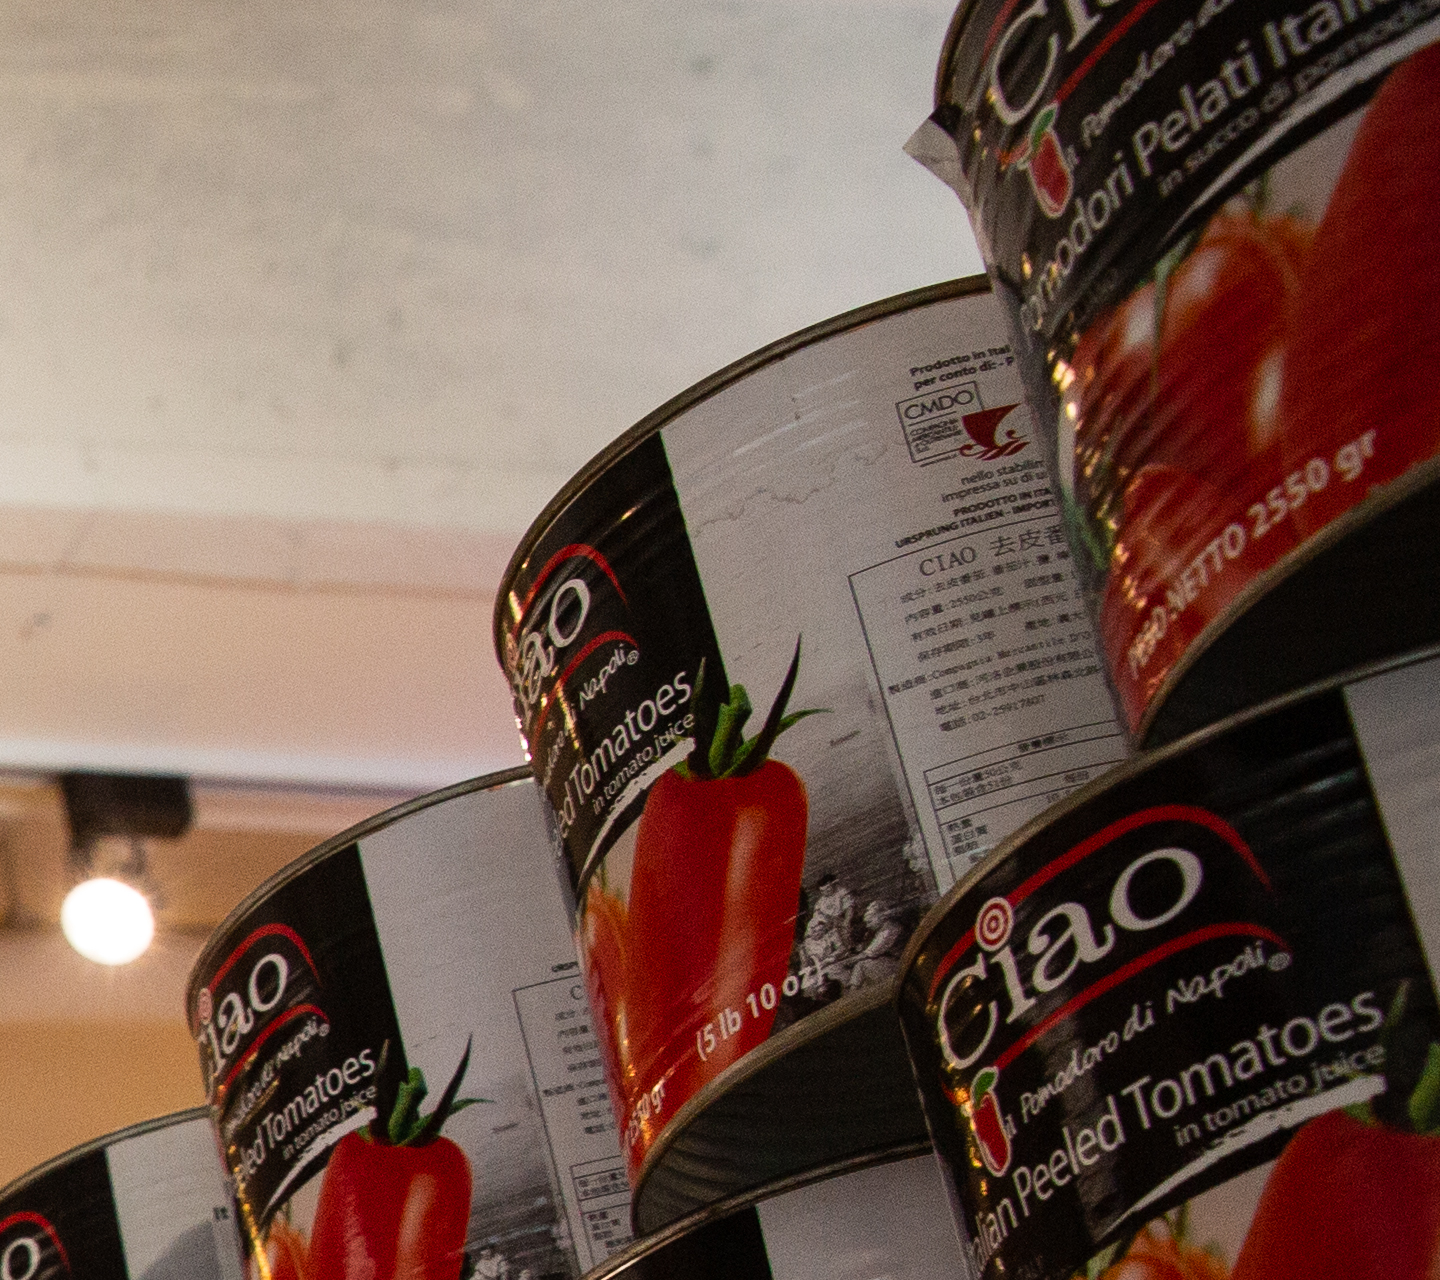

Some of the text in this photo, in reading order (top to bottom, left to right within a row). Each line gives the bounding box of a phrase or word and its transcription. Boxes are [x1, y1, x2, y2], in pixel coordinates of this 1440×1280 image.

[1132, 39, 1261, 177] Pelati
[904, 389, 975, 420] CMDO
[938, 366, 978, 383] conto
[1247, 456, 1330, 540] 2550
[1334, 428, 1379, 483] gr
[919, 546, 978, 576] CIAO
[569, 671, 693, 806] Tomatoes
[603, 744, 655, 801] tomato
[938, 847, 1204, 1070] Ciao
[695, 1029, 716, 1062] (5
[717, 1008, 742, 1040] lb
[746, 982, 777, 1019] 10
[1020, 1031, 1121, 1123] Pomodoro
[1121, 1001, 1156, 1043] di
[263, 1049, 376, 1149] Tomatoes
[1012, 1094, 1127, 1217] Peeled
[1121, 989, 1383, 1130] Tomatoes
[1175, 1118, 1202, 1147] in
[1204, 1069, 1309, 1133] tomato
